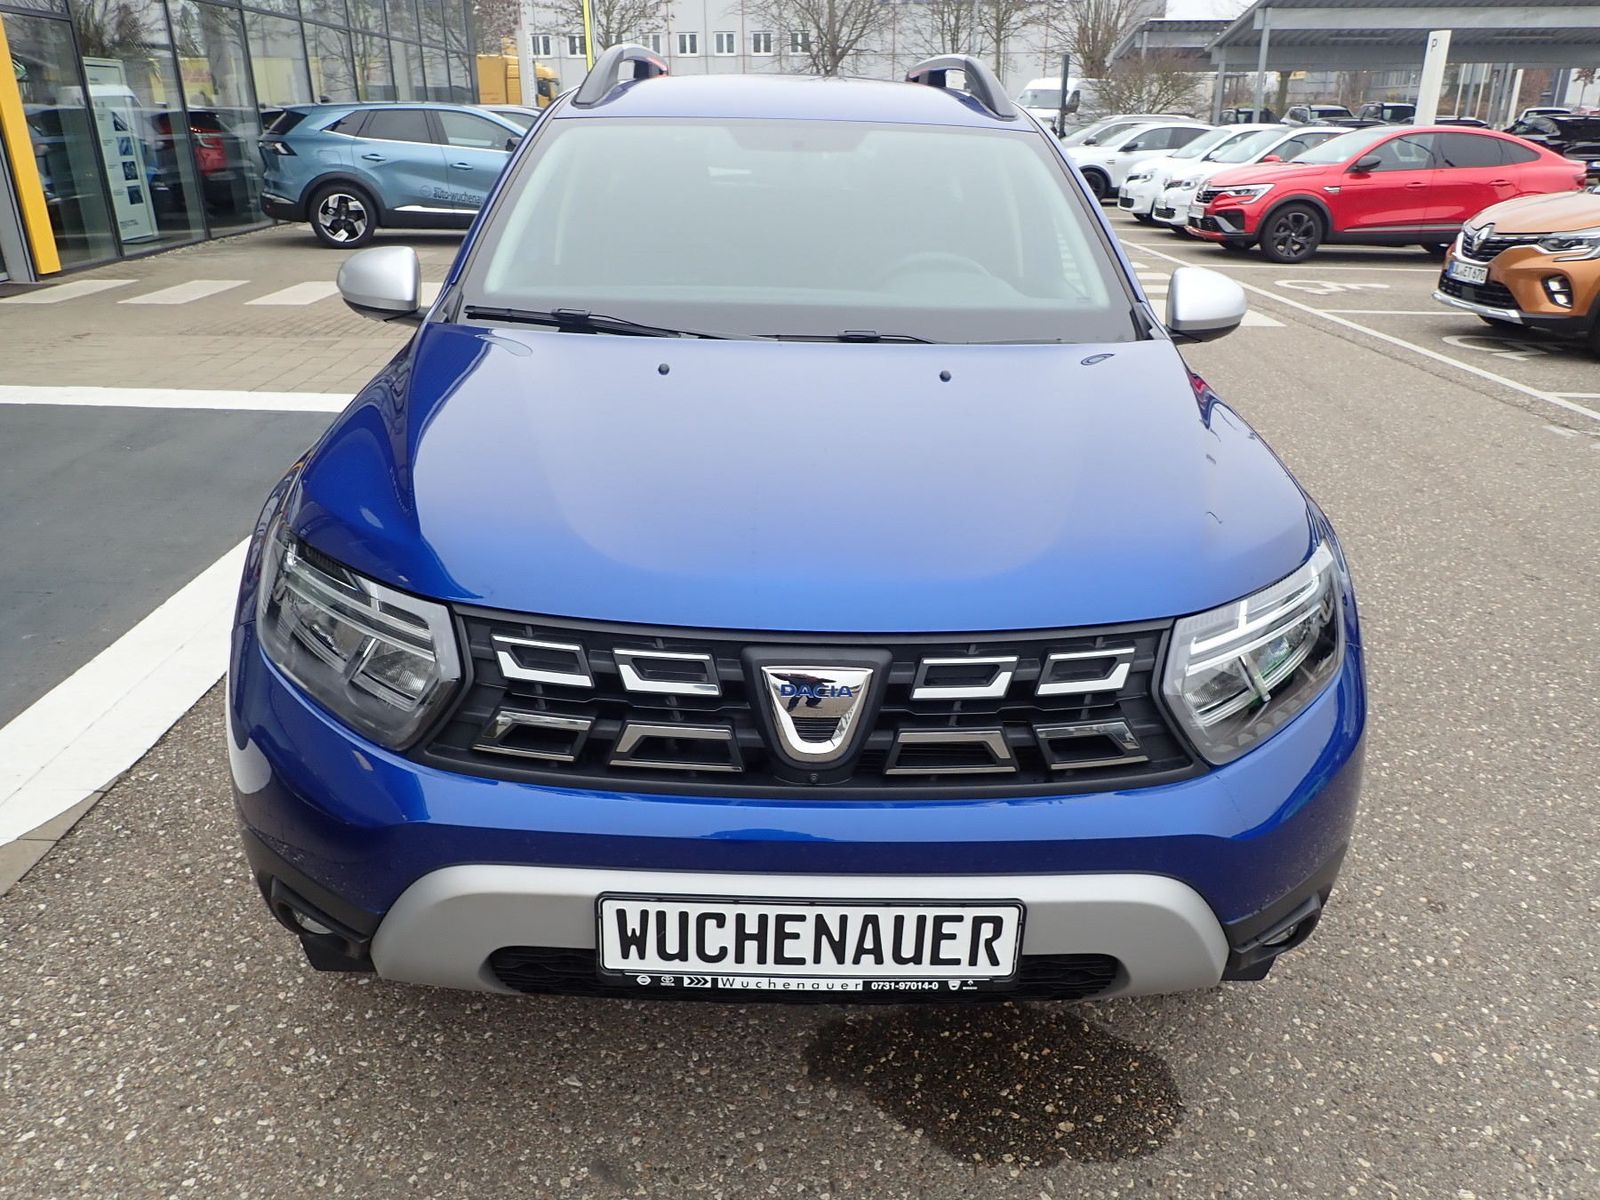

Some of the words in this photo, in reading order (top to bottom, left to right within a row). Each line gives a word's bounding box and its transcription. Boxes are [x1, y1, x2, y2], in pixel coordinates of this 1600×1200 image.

[1431, 38, 1438, 52] P
[780, 684, 853, 698] DACIA
[614, 907, 1005, 967] WUCHENAUER
[720, 977, 861, 990] Wuchenauer
[871, 981, 939, 991] 0731-97014-0
